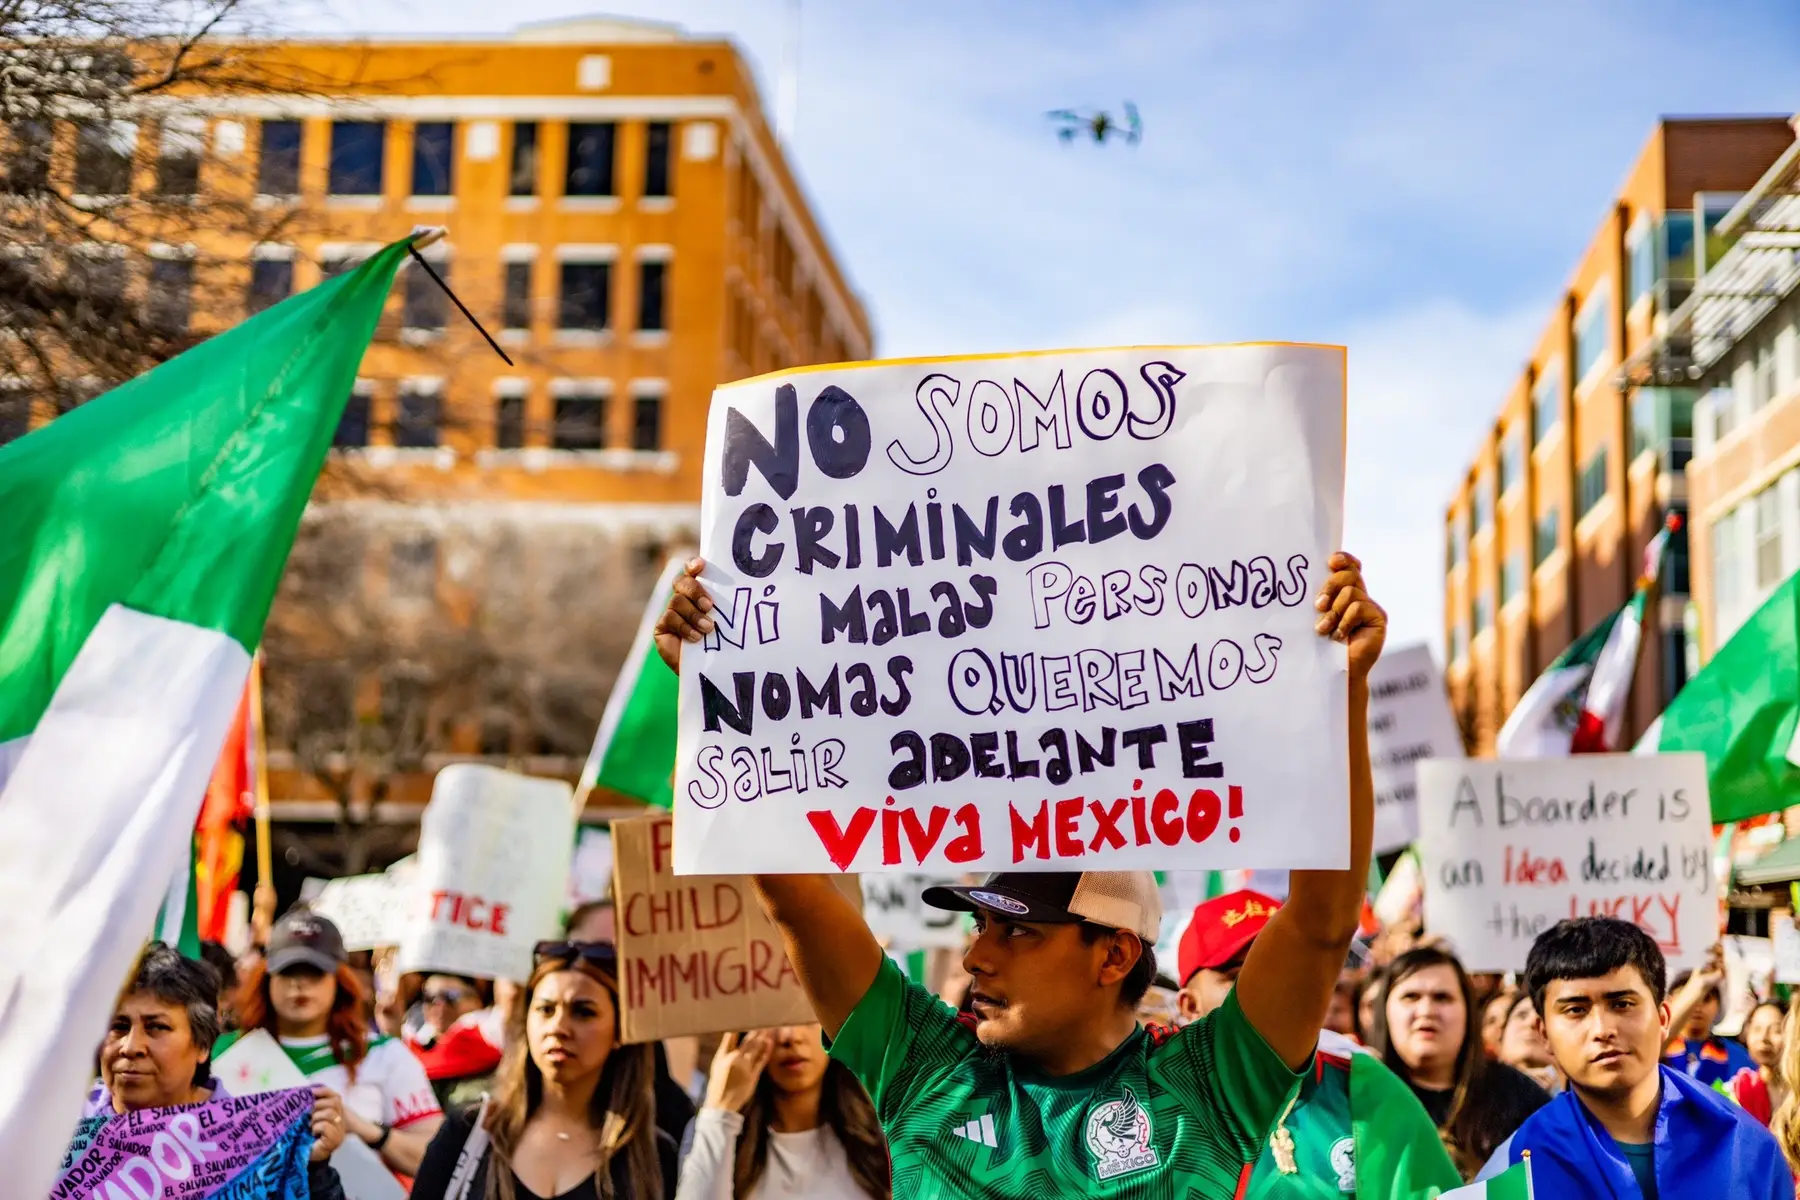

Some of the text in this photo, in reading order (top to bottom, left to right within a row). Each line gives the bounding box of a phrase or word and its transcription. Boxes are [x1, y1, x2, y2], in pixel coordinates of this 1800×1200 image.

[722, 361, 1187, 498] NO SOMOS
[947, 632, 1282, 717] QUEREMOS
[1449, 771, 1692, 829] A boarder is
[1440, 857, 1484, 890] an
[1581, 836, 1670, 885] decided
[1682, 844, 1710, 895] by
[430, 888, 512, 937] TICE
[624, 882, 744, 938] CHILD
[1486, 903, 1547, 940] the
[625, 938, 802, 1011] IMMIGRA
[128, 1110, 144, 1128] EL
[131, 1122, 166, 1137] SALVADOR
[198, 1109, 218, 1129] EL
[251, 1122, 268, 1140] EL
[108, 1137, 152, 1158] SALVADOR
[192, 1164, 203, 1177] EL
[205, 1154, 250, 1175] SALVADOR
[49, 1148, 106, 1200] VADOR
[84, 1151, 125, 1191] SALVADOR
[164, 1173, 227, 1198] EL SALVADOR
